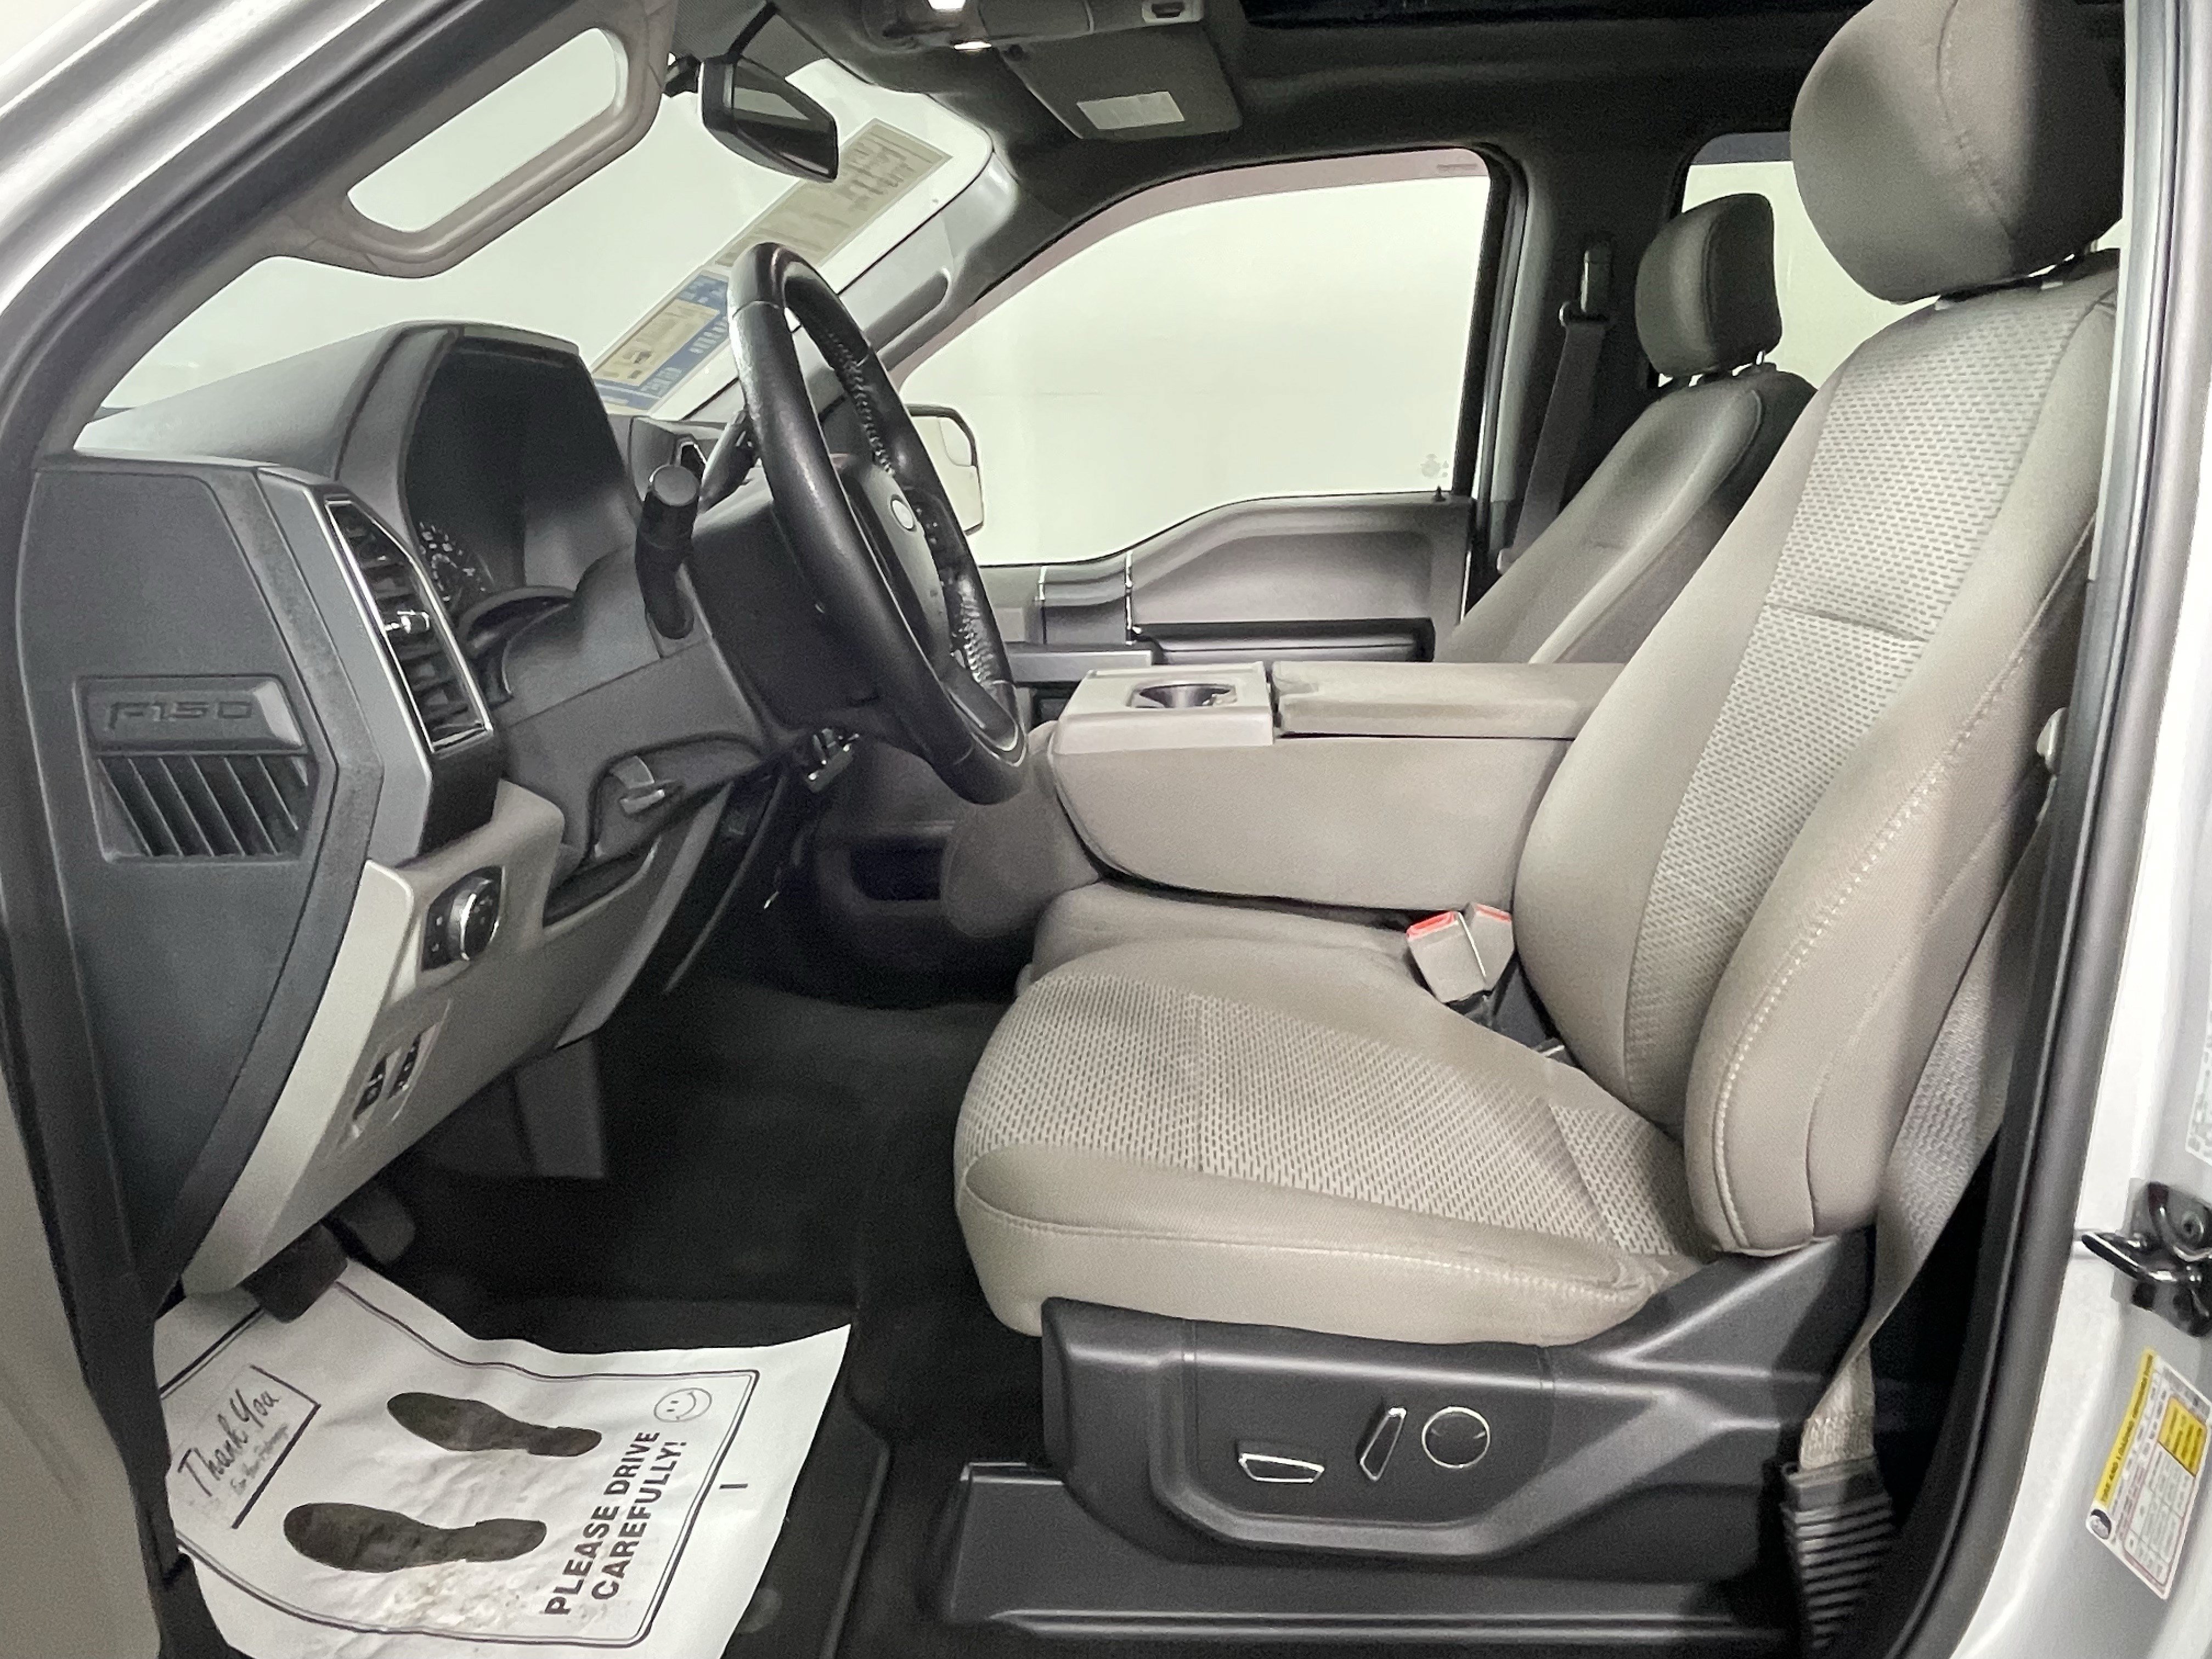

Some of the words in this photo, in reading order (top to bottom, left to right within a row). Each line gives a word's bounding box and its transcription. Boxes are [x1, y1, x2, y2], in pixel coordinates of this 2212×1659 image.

[177, 1413, 249, 1497] Thank
[229, 1388, 280, 1429] You
[591, 1442, 687, 1600] CAREFULLY!
[544, 1506, 620, 1615] PLEASE
[603, 1432, 660, 1495] DRIVE
